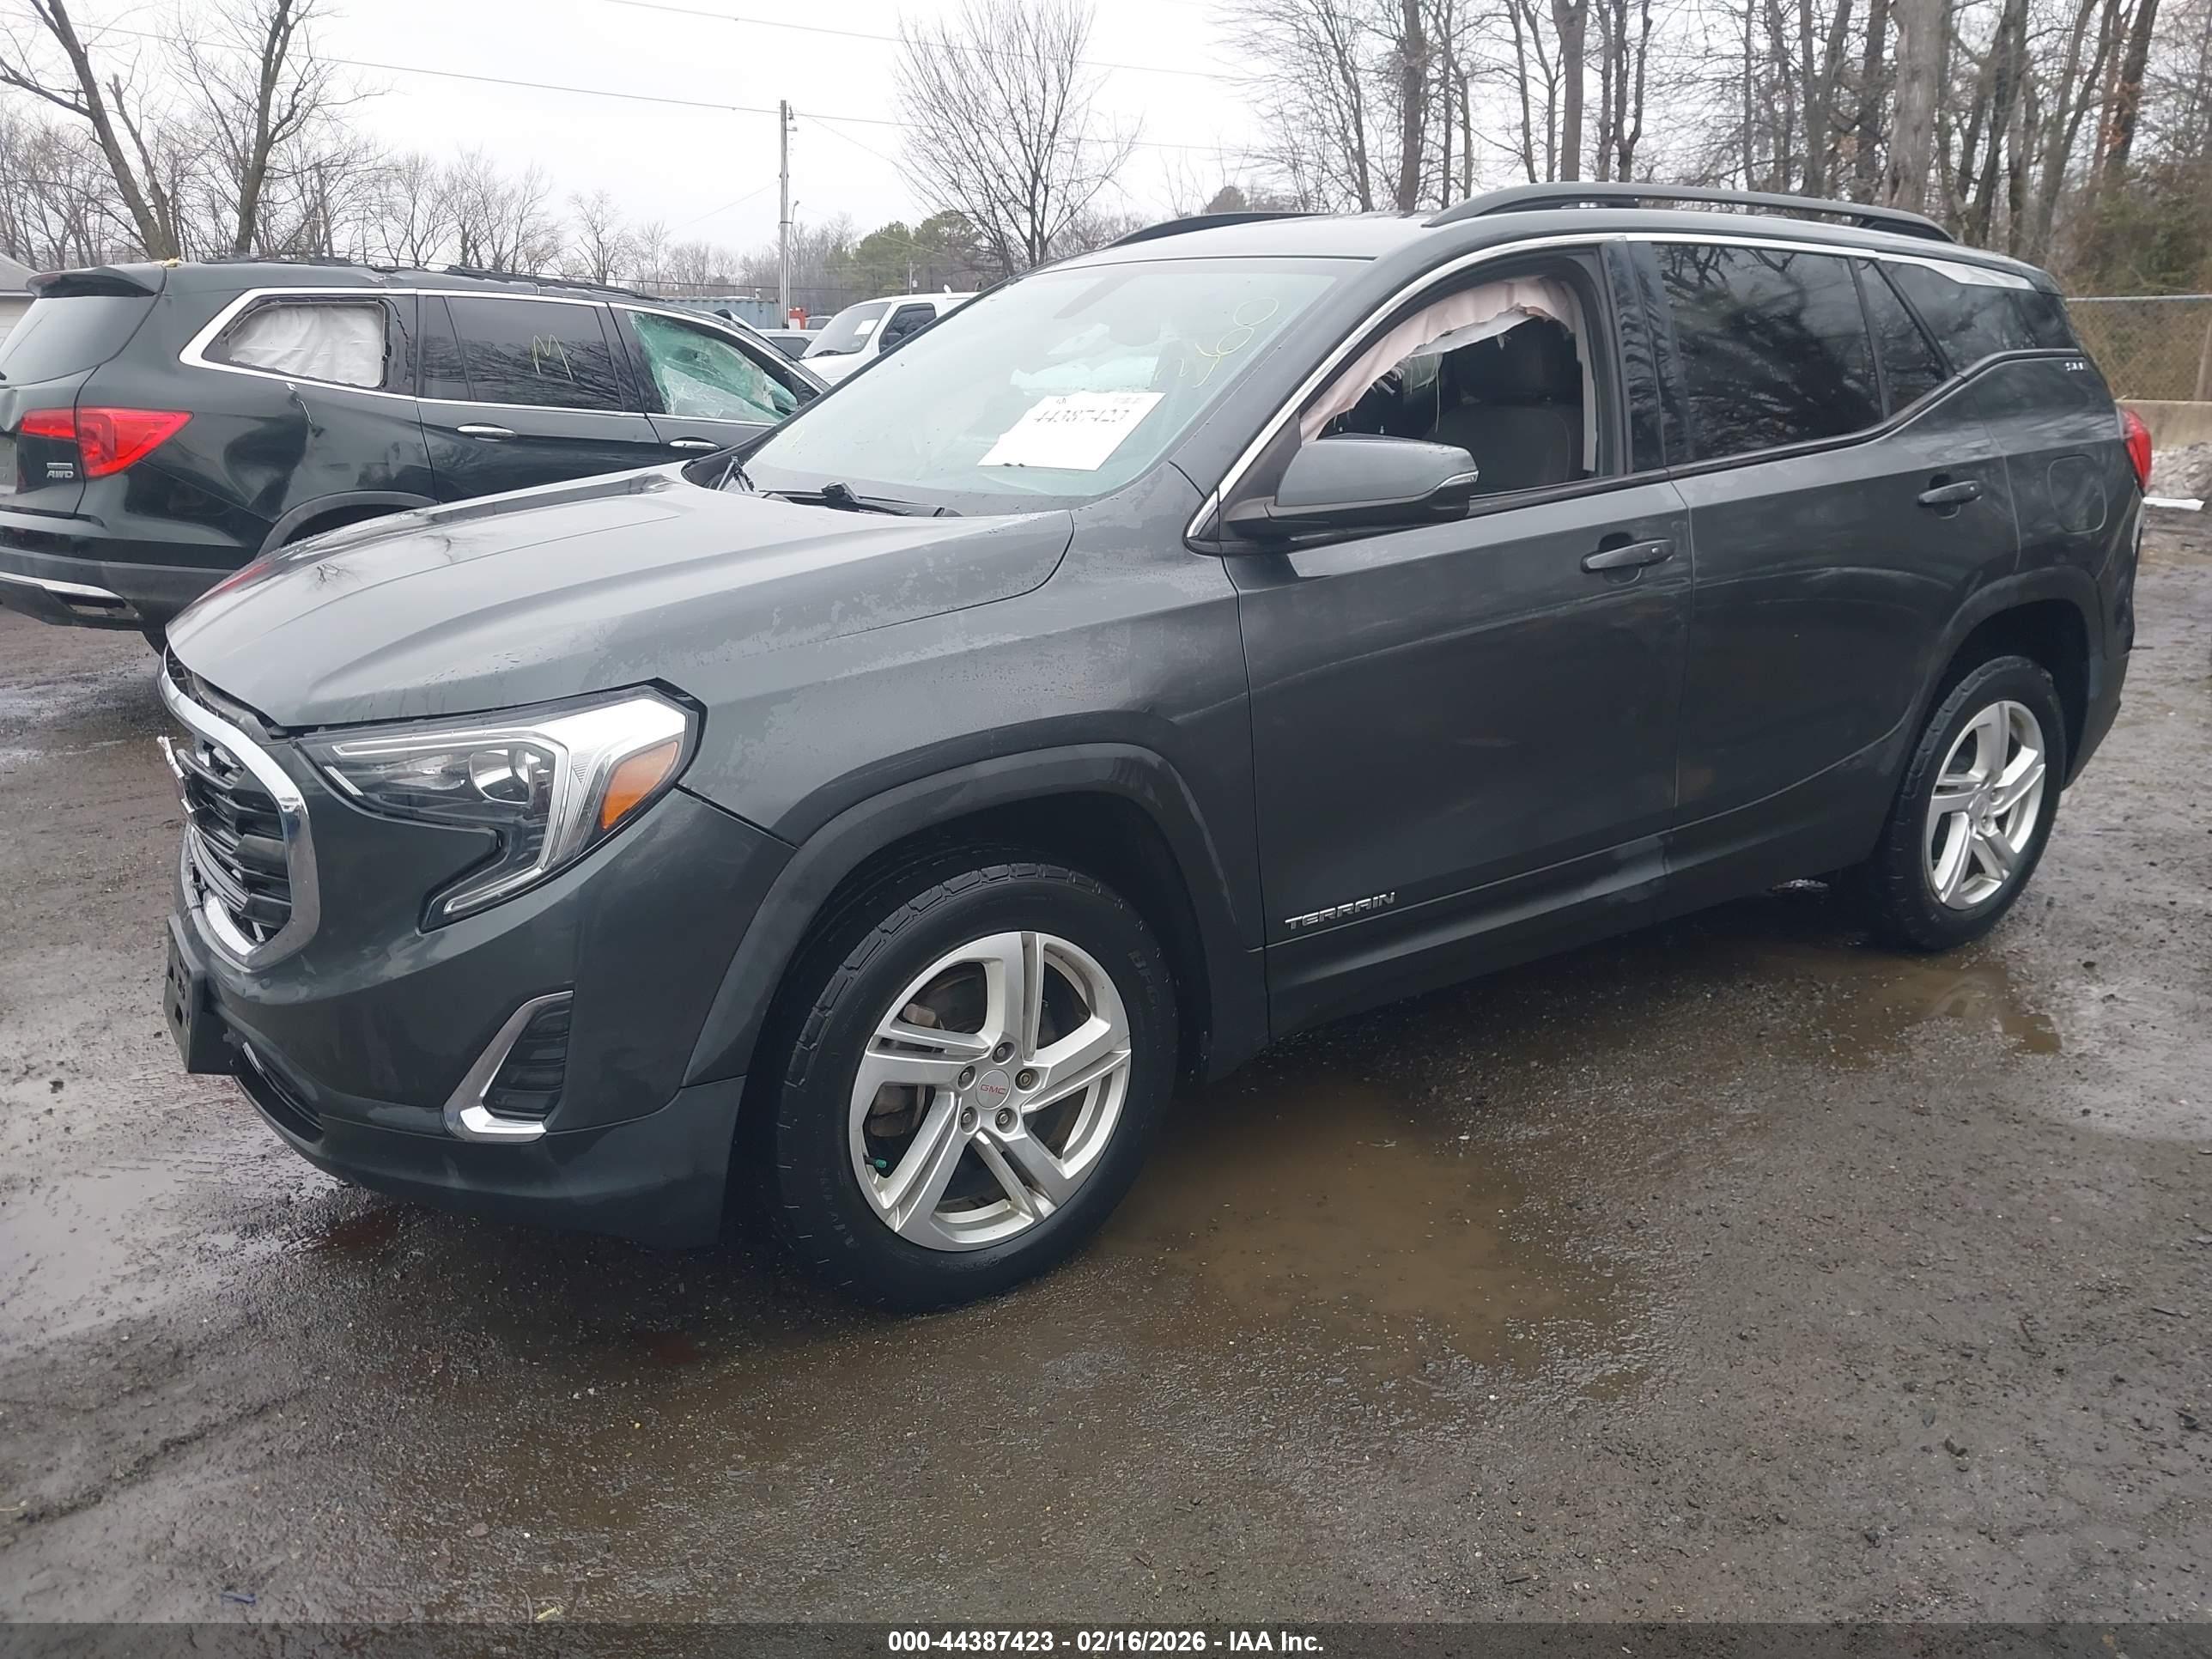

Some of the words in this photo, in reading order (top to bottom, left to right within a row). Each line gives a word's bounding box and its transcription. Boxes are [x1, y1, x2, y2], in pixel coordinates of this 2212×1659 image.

[46, 470, 75, 479] AWD
[1285, 891, 1395, 930] TERRAIN
[980, 1084, 1006, 1095] GMC
